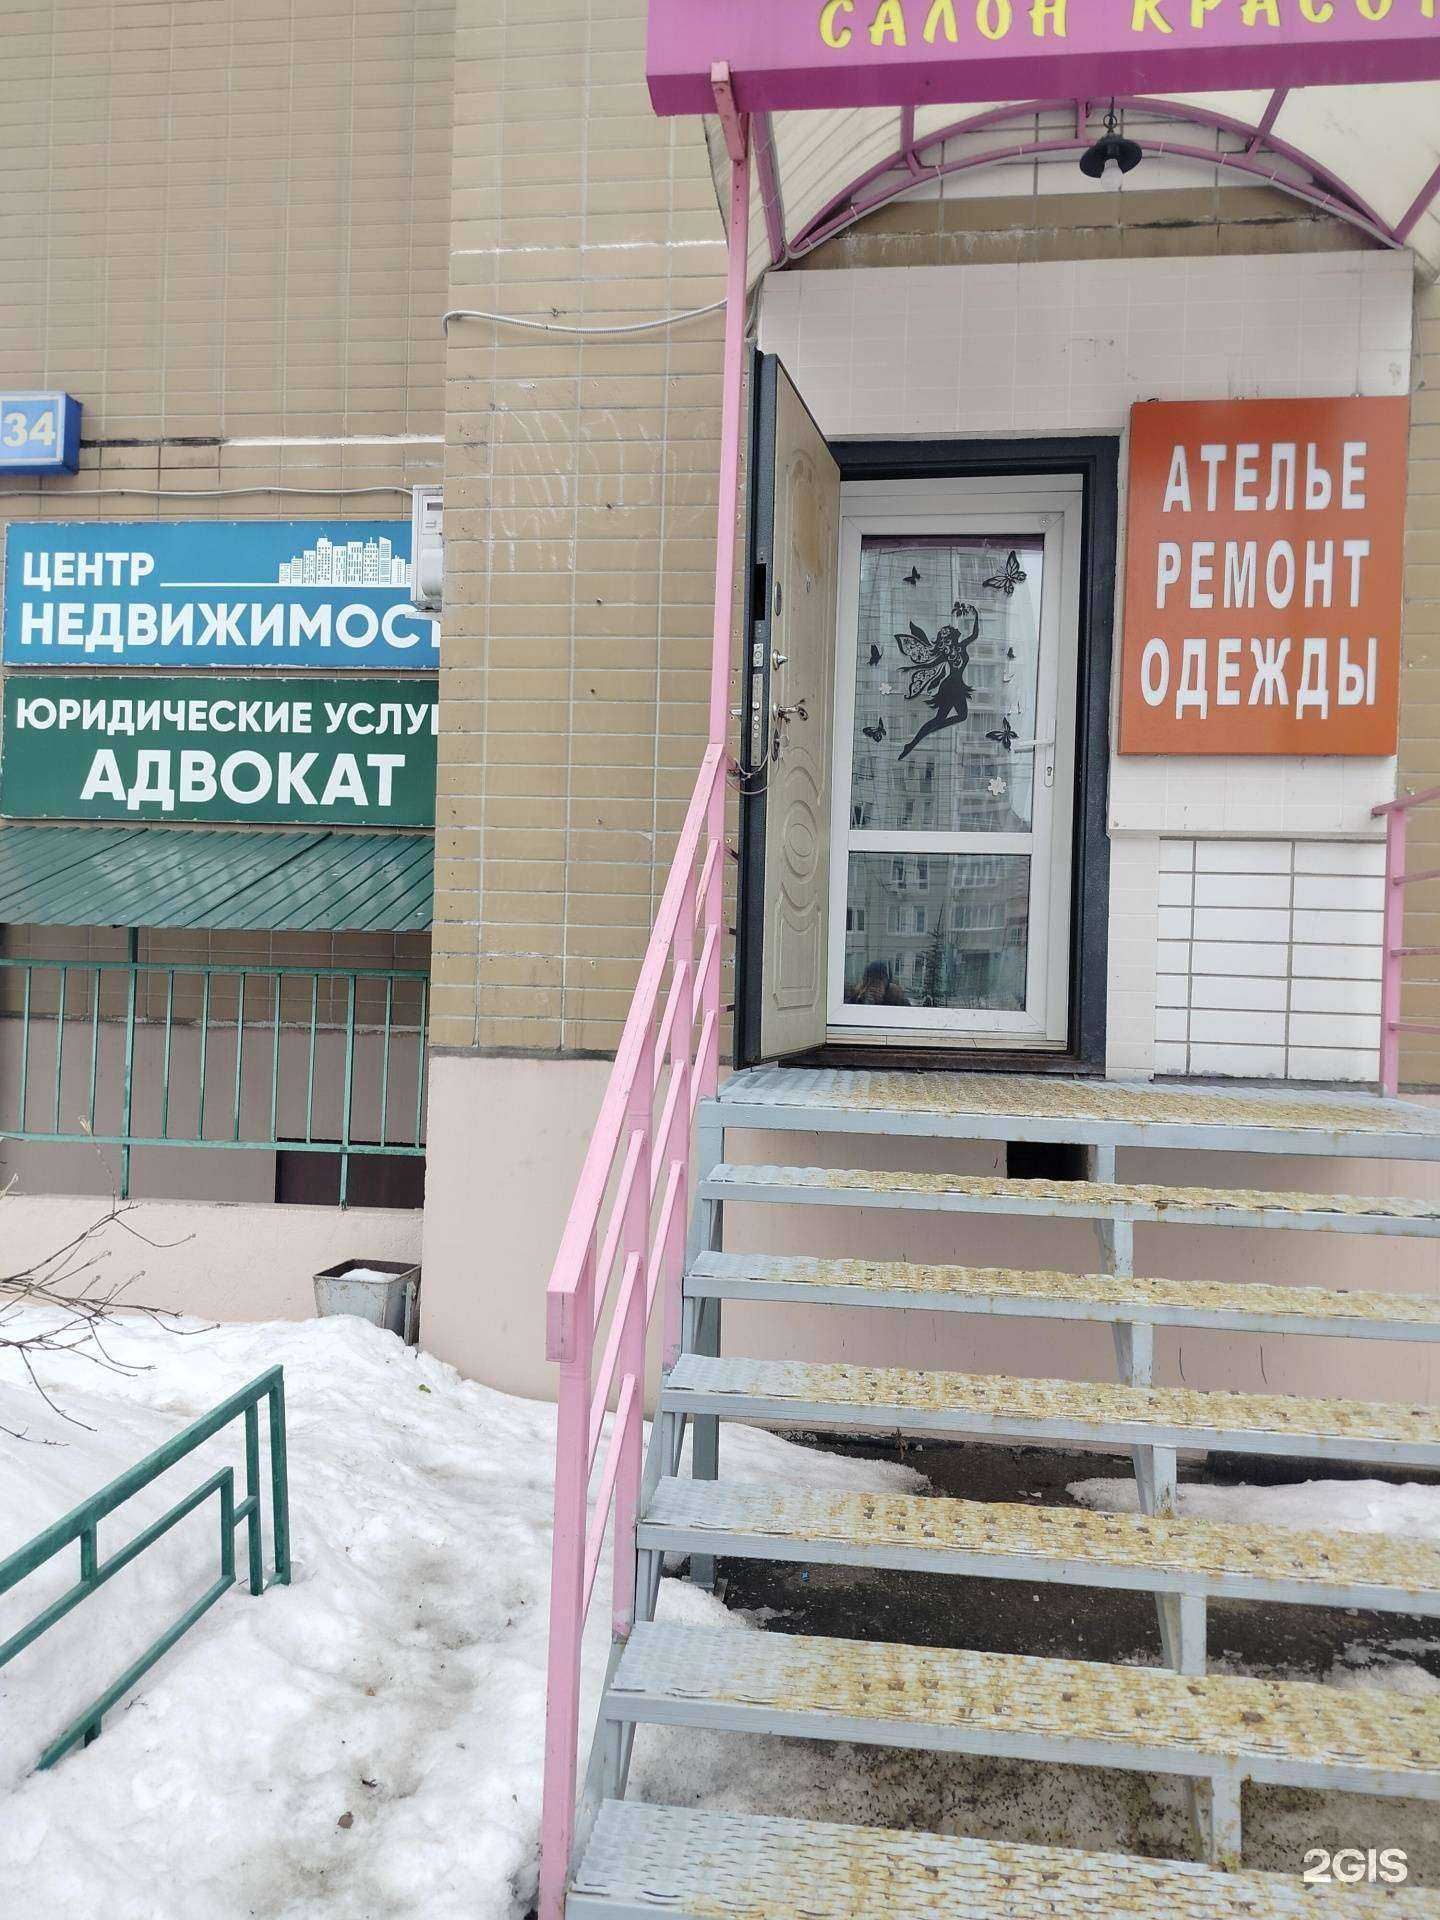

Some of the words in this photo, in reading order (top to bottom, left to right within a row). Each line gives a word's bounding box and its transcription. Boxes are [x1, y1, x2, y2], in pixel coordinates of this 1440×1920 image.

[819, 0, 1068, 48] САЛОН
[3, 411, 56, 448] 34
[1162, 441, 1367, 512] АТЕЛЬЕ
[22, 551, 155, 592] ЦЕНТР
[1156, 539, 1371, 610] РЕМОНТ
[1140, 637, 1378, 720] ОДЕЖДЫ
[16, 698, 312, 737] ЮРИДИЧЕСКИЕ
[79, 748, 406, 811] АДВОКАТ
